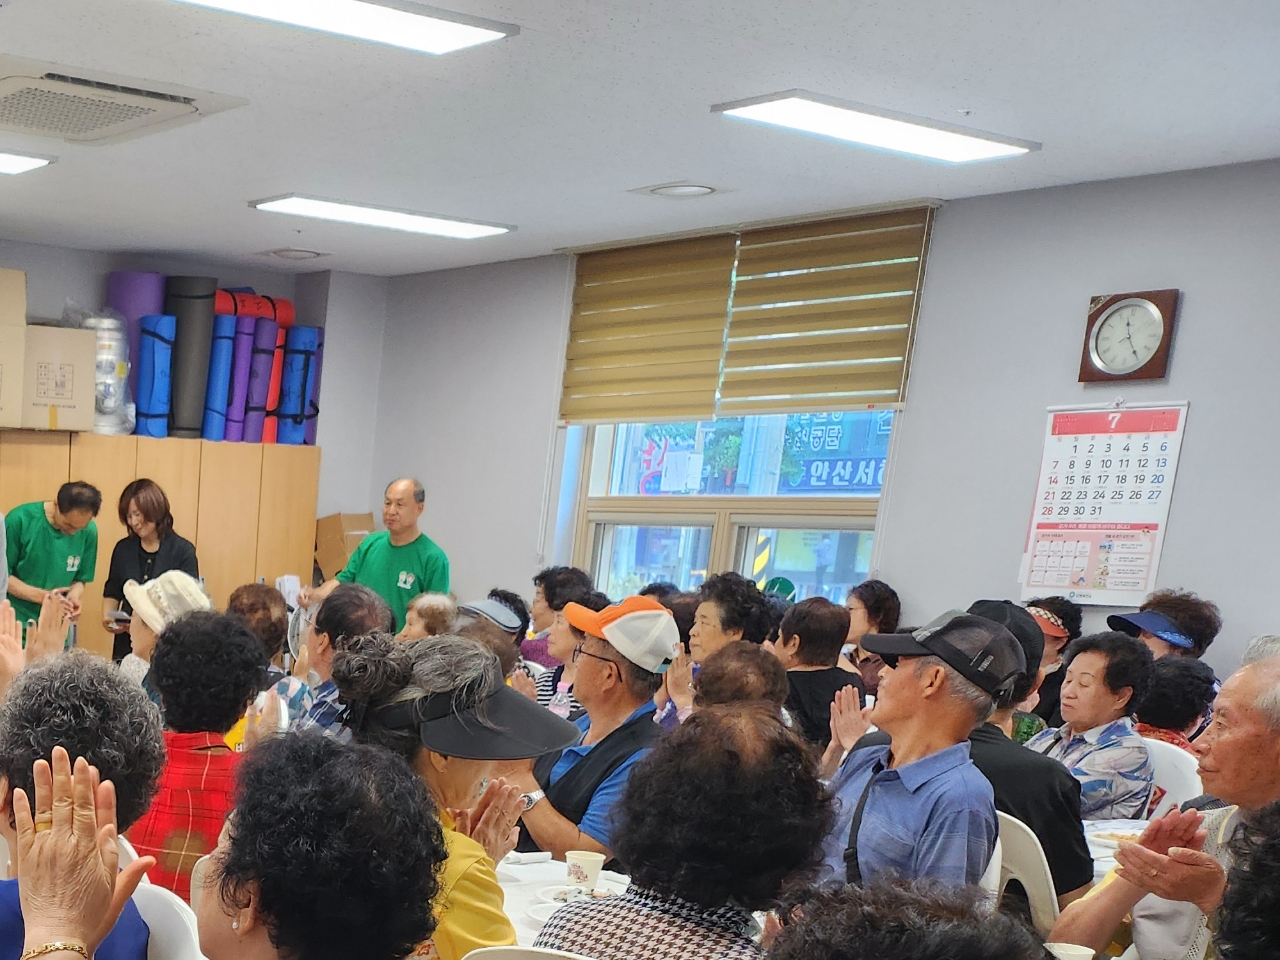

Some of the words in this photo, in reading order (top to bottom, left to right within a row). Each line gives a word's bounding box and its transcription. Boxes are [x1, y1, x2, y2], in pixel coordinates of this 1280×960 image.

[1108, 413, 1121, 429] 7
[1073, 445, 1078, 453] 1
[1088, 444, 1094, 453] 2
[1105, 444, 1111, 453] 3
[1123, 443, 1130, 452] 4
[1142, 443, 1148, 452] 5
[1160, 442, 1167, 451] 6
[1053, 461, 1059, 469] 7
[1068, 460, 1075, 469] 8
[1085, 460, 1092, 468] 9
[1100, 459, 1112, 468] 10
[1119, 459, 1130, 468] 11
[1137, 459, 1148, 468] 12
[1156, 458, 1167, 467] 13
[1048, 476, 1058, 485] 14
[1065, 476, 1075, 484] 15
[1081, 475, 1091, 484] 16
[1098, 475, 1109, 484] 17
[1116, 475, 1127, 483] 18
[1134, 475, 1145, 483] 19
[1150, 474, 1164, 483] 20
[1044, 491, 1055, 500] 21
[1060, 491, 1072, 500] 22
[1076, 491, 1087, 500] 23
[1093, 491, 1105, 499] 24
[1111, 491, 1124, 499] 25
[1129, 490, 1142, 499] 26
[1147, 490, 1162, 499] 27
[1042, 507, 1053, 515] 28
[1058, 506, 1069, 515] 29
[1073, 506, 1085, 515] 30
[1090, 506, 1102, 515] 31
